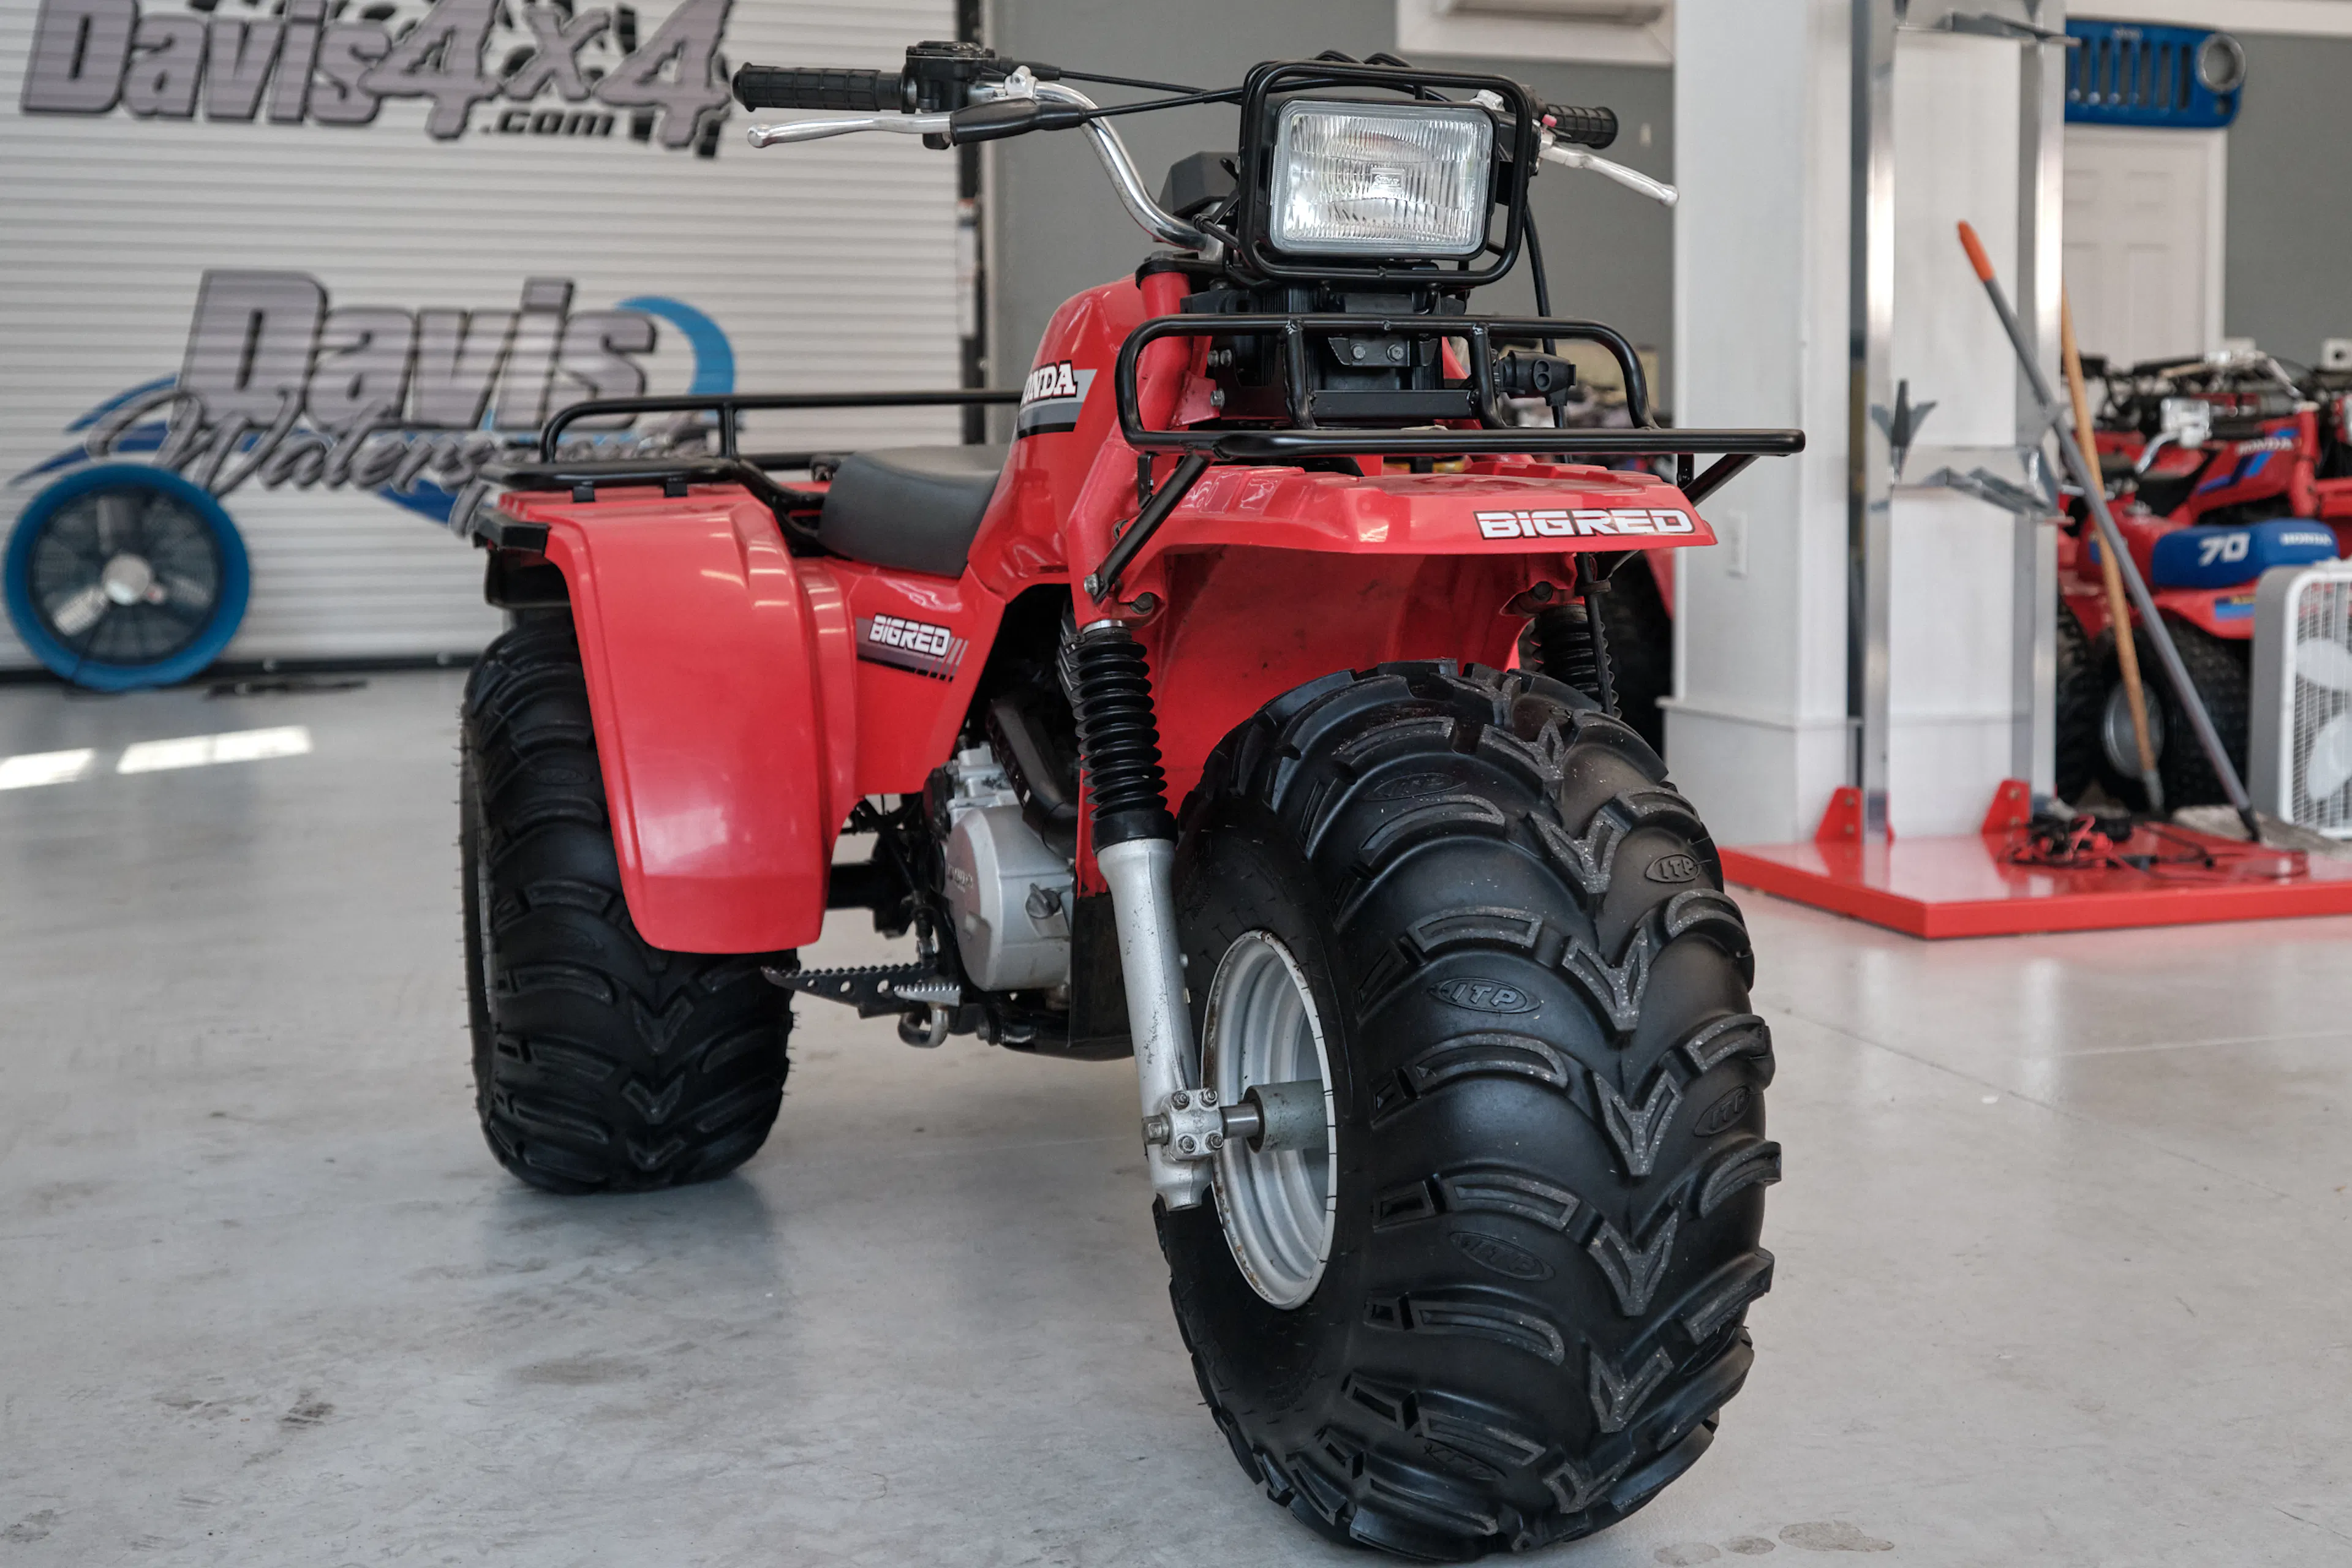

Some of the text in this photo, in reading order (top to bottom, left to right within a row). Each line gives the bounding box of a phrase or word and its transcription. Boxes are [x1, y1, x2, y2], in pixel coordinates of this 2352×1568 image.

[480, 108, 616, 136] .com
[176, 270, 657, 431] Davis
[1019, 360, 1078, 407] ONDA
[2236, 435, 2294, 456] HONDA
[2198, 532, 2251, 567] 70
[1658, 856, 1695, 880] ITP
[1450, 982, 1518, 1008] ITP
